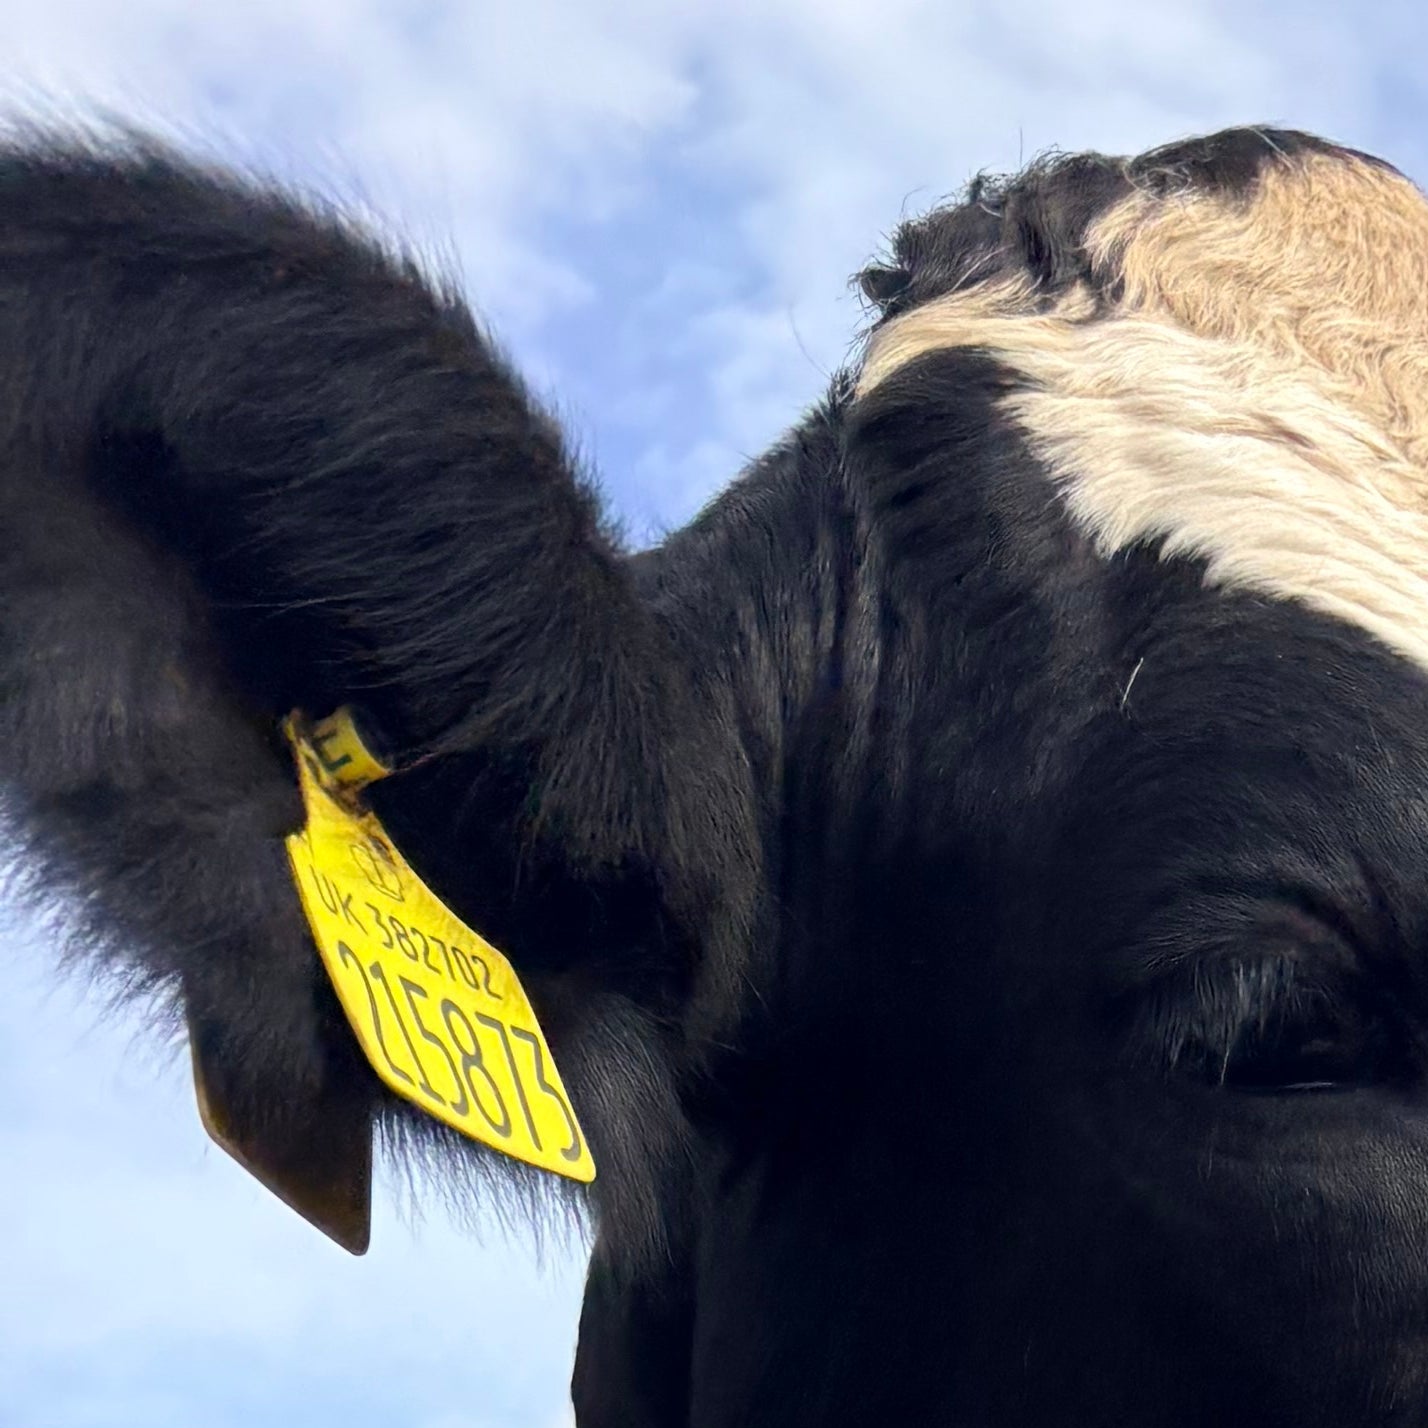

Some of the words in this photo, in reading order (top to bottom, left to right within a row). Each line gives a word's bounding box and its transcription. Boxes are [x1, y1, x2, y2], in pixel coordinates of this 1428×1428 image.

[309, 864, 369, 937] UK
[365, 902, 504, 1000] 382702
[338, 940, 582, 1162] 215873
